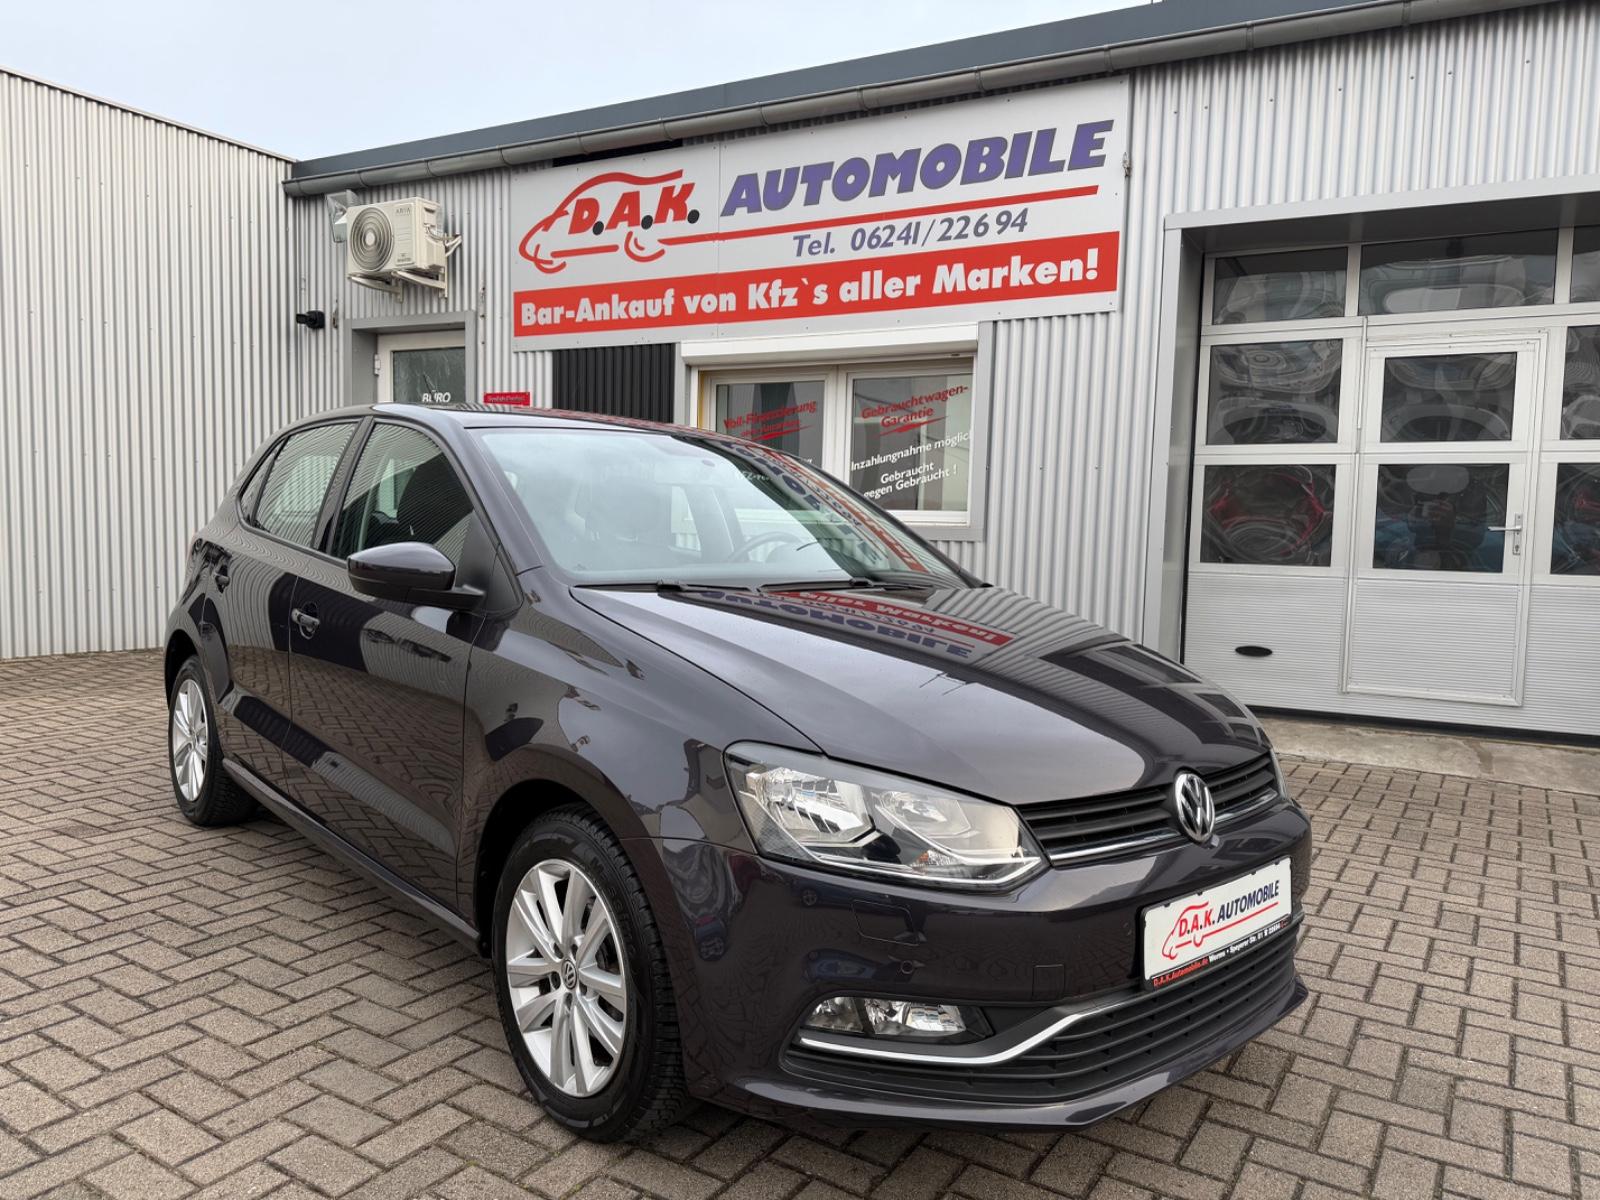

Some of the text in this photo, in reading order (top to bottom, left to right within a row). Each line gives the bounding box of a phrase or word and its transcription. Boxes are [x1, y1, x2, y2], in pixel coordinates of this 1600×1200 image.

[568, 119, 1114, 236] D.A.K. AUTOMOBILE
[793, 231, 836, 257] Tel.
[521, 288, 674, 327] Bar-Ankauf
[684, 291, 737, 315] von
[839, 269, 921, 302] aller
[932, 247, 1099, 294] Marken!
[861, 385, 968, 419] Gebrauchtwagen-
[881, 406, 934, 428] Garantie
[851, 431, 972, 472] Inzahlungnahme möglic
[880, 461, 935, 484] Gebraucht
[895, 468, 950, 491] Gebraucht
[1178, 909, 1216, 938] D.A.K.
[1217, 880, 1280, 924] AUTOMOBILE
